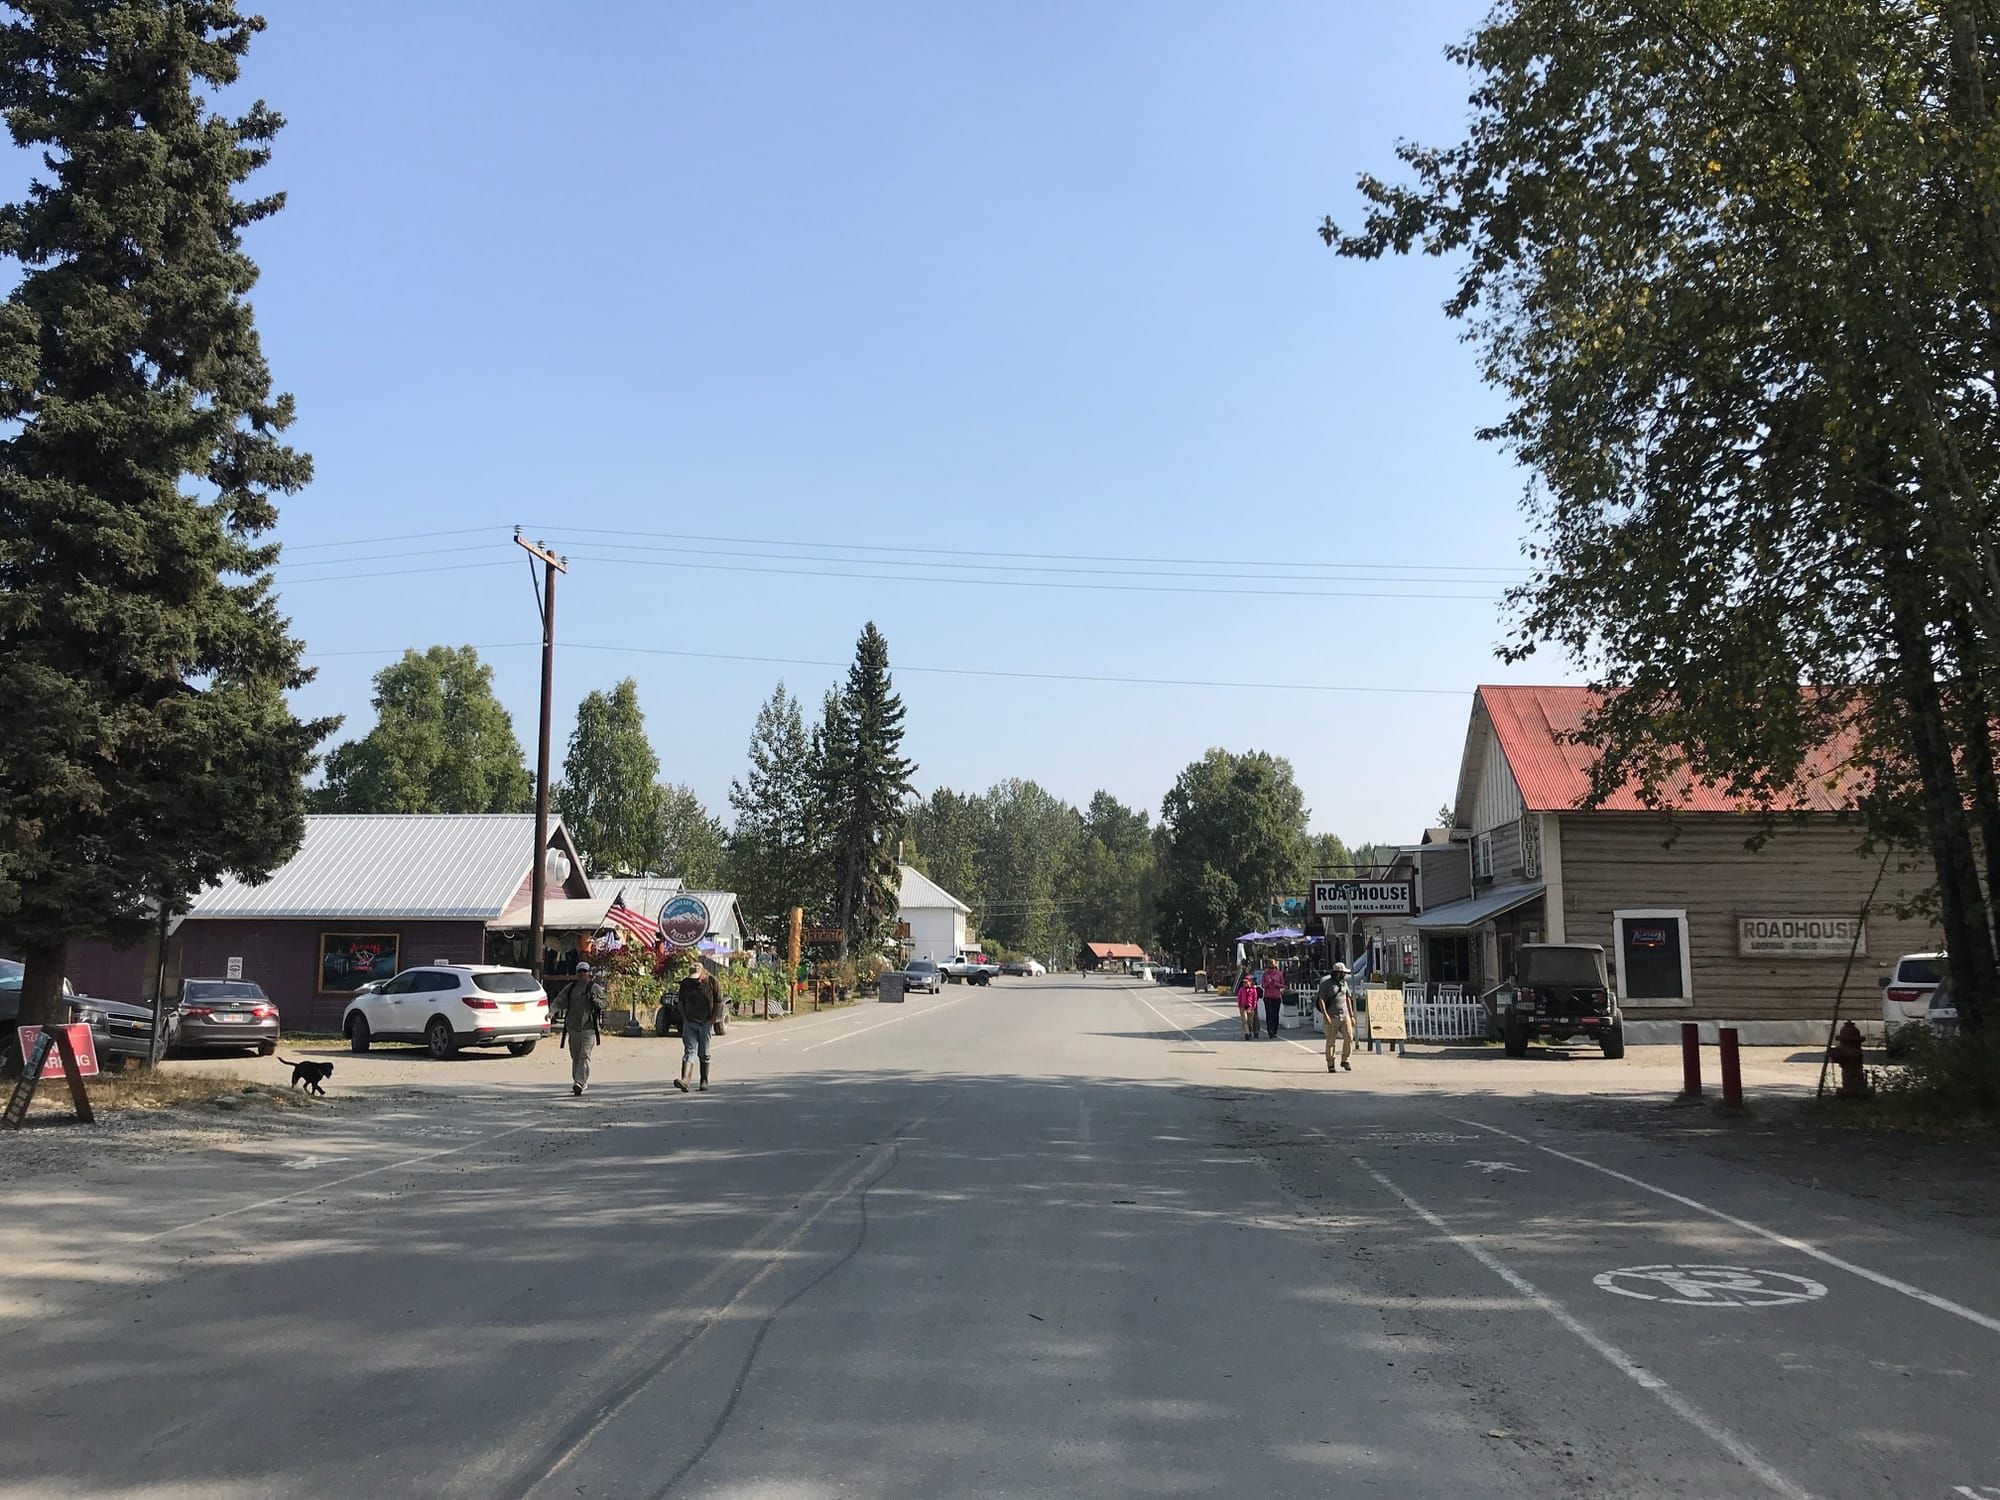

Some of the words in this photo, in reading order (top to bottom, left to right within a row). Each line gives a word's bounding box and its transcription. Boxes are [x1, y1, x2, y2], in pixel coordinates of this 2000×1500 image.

[1524, 816, 1535, 877] LODGING
[1743, 921, 1859, 939] ROADHOUSE
[1371, 991, 1398, 1001] FISH
[1375, 1002, 1396, 1012] ART
